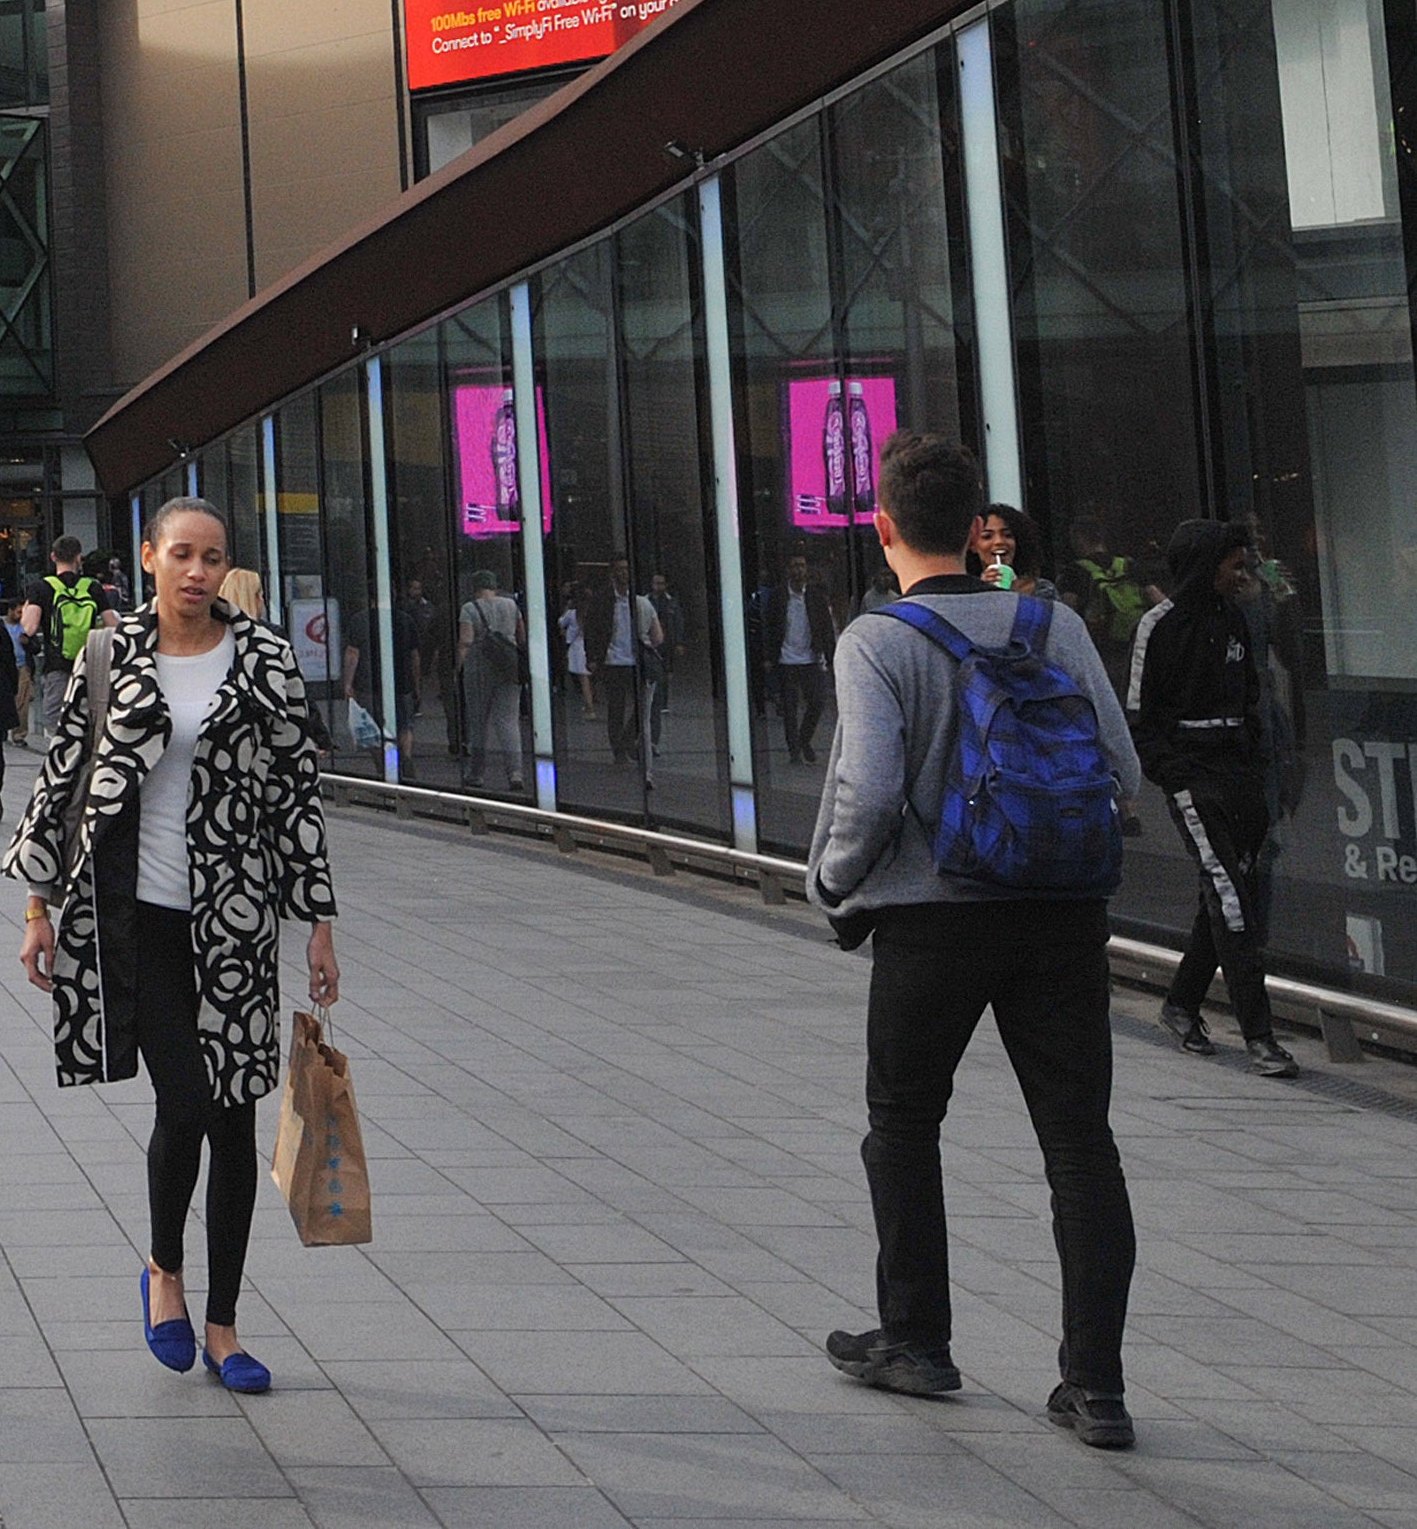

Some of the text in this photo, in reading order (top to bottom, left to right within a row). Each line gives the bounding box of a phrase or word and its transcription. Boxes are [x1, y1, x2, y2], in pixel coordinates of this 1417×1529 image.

[430, 11, 476, 33] 100Mbs
[477, 6, 502, 23] free
[432, 33, 479, 55] Connect
[480, 30, 493, 45] to
[554, 13, 580, 32] Free
[620, 3, 637, 19] on
[1332, 737, 1417, 839] ST
[1345, 843, 1368, 880] &
